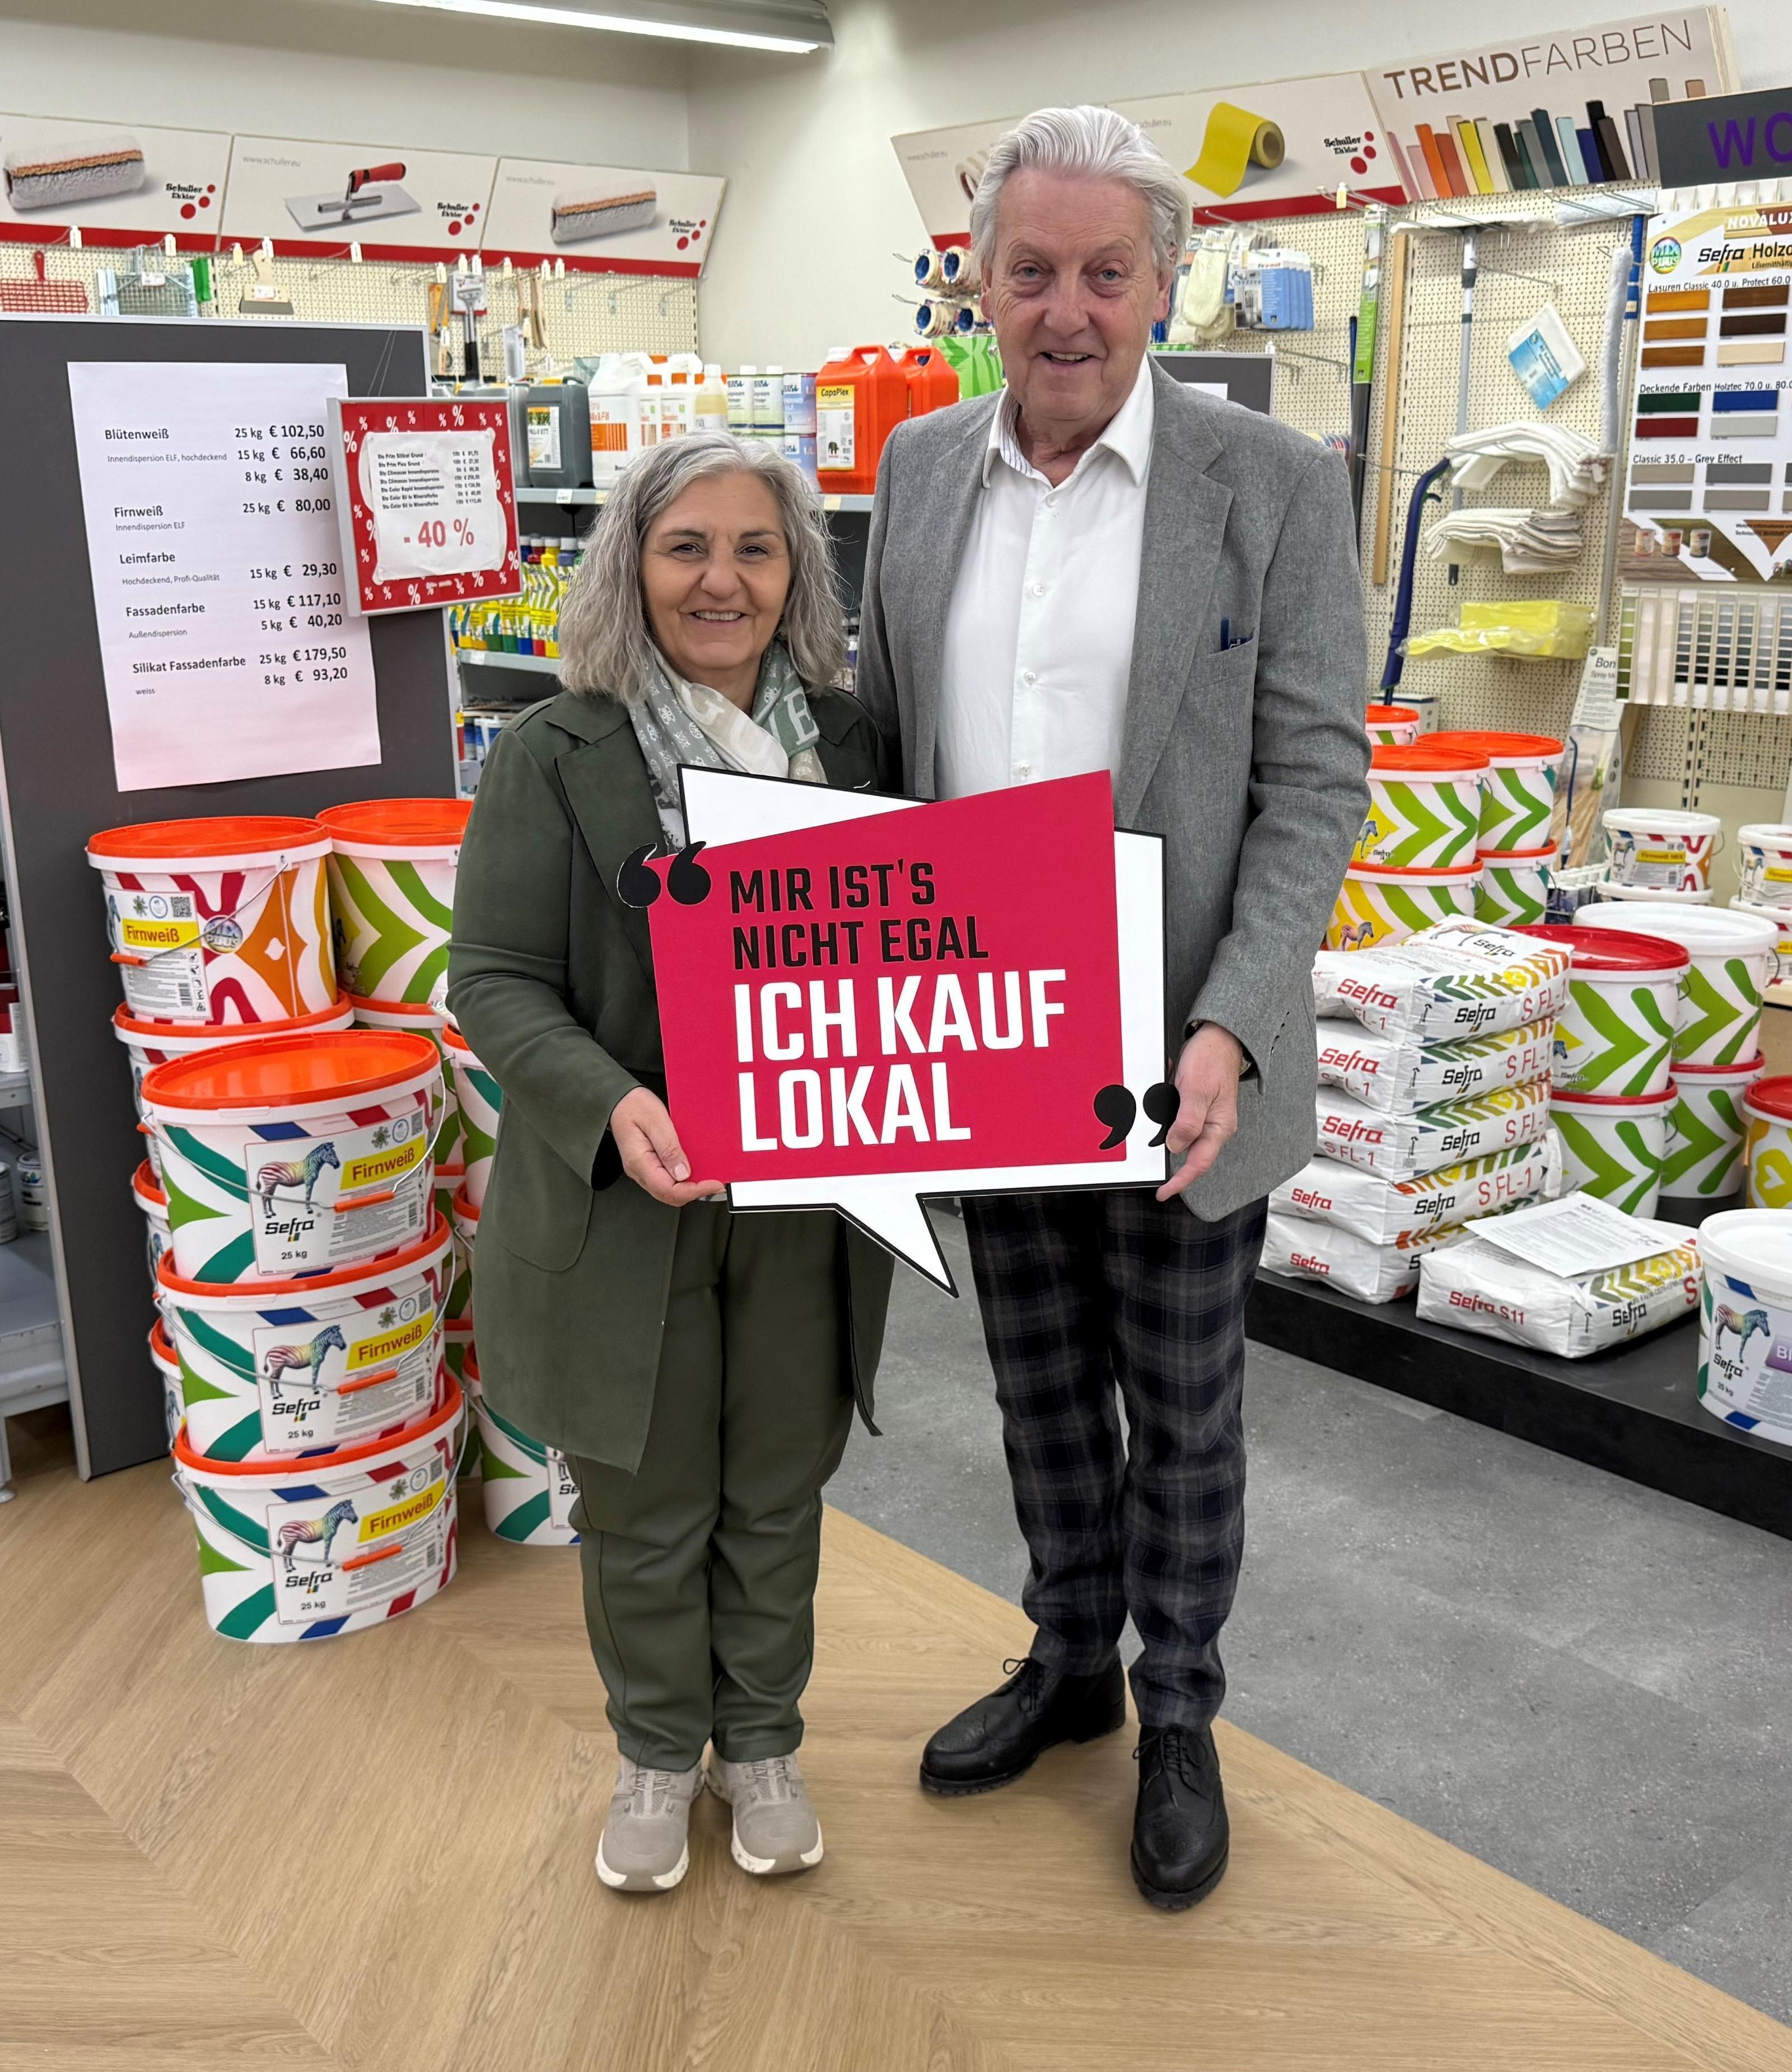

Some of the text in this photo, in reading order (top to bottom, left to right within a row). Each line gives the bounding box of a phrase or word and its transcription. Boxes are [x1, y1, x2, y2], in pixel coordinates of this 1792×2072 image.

[1384, 19, 1692, 99] TRENDFARBEN
[1324, 136, 1361, 148] Schuller
[166, 183, 203, 193] Schuller
[437, 202, 469, 212] Schuller
[1698, 244, 1745, 265] Sefra
[1649, 283, 1680, 292] Lasuren
[1684, 282, 1709, 290] Classic
[1742, 278, 1770, 287] Protect
[1772, 275, 1791, 284] 60.0
[1640, 383, 1679, 392] Deckende
[1683, 382, 1711, 391] Farben
[1745, 381, 1762, 390] 70.0
[105, 424, 324, 441] Blütenweiß 25 kg € 102,50
[108, 453, 227, 464] Innendispersion ELF, hochdeckend
[237, 446, 325, 462] 15 kg € 66,60
[1633, 455, 1662, 464] Classic
[1664, 454, 1684, 464] 35.0
[1695, 454, 1714, 464] Grey
[1718, 453, 1743, 463] Effect
[245, 467, 328, 484] 8 kg € 38,40
[114, 498, 331, 518] Firnweiß 25 kg € 80,00
[115, 521, 185, 531] Innendispersion ELF
[418, 520, 446, 548] 40
[454, 518, 474, 546] %
[119, 553, 176, 564] Leimfarbe
[123, 574, 220, 586] Hochdeckend, Profi-Qualität
[250, 563, 337, 581] 15 kg € 29,30
[126, 593, 340, 617] Fassadenfarbe 15 kg € 117,10
[261, 614, 342, 632] 5 kg € 40,20
[128, 628, 188, 639] Außendispersion
[133, 647, 347, 673] Silikat Fassadenfarbe 25 kg € 179,50
[1595, 657, 1616, 668] Bon
[264, 667, 348, 686] 8 kg € 93,20
[136, 687, 155, 696] weiss
[730, 858, 936, 914] MIR IST'S
[126, 924, 180, 943] Firnweiß
[734, 915, 989, 970] NICHT EGAL
[1473, 939, 1515, 957] Sefra
[1337, 979, 1398, 1009] Sefra
[735, 968, 1066, 1063] ICH KAUF
[1454, 1003, 1496, 1027] Sefra
[1318, 1048, 1379, 1074] Sefra
[1441, 1065, 1482, 1089] Sefra
[738, 1061, 971, 1152] LOKAL
[1322, 1115, 1383, 1144] Sefra
[1440, 1128, 1480, 1153] Sefra
[352, 1148, 414, 1181] Firnweiß
[1291, 1188, 1332, 1210] Sefra
[1413, 1194, 1455, 1219] Sefra
[265, 1218, 314, 1236] Sefra
[281, 1250, 307, 1260] 25 kg
[1290, 1253, 1330, 1275] Sefra
[1449, 1290, 1525, 1325] Sefra S11
[1612, 1302, 1647, 1328] Sefra
[358, 1324, 422, 1361] Firnweiß
[1714, 1353, 1743, 1377] Sefra
[1718, 1382, 1734, 1397] 25 kg
[272, 1399, 320, 1416] Sefra
[302, 1429, 314, 1438] kg
[370, 1493, 434, 1533] Firnweiß
[285, 1571, 333, 1589] Sefra
[301, 1600, 326, 1610] 25 kg
